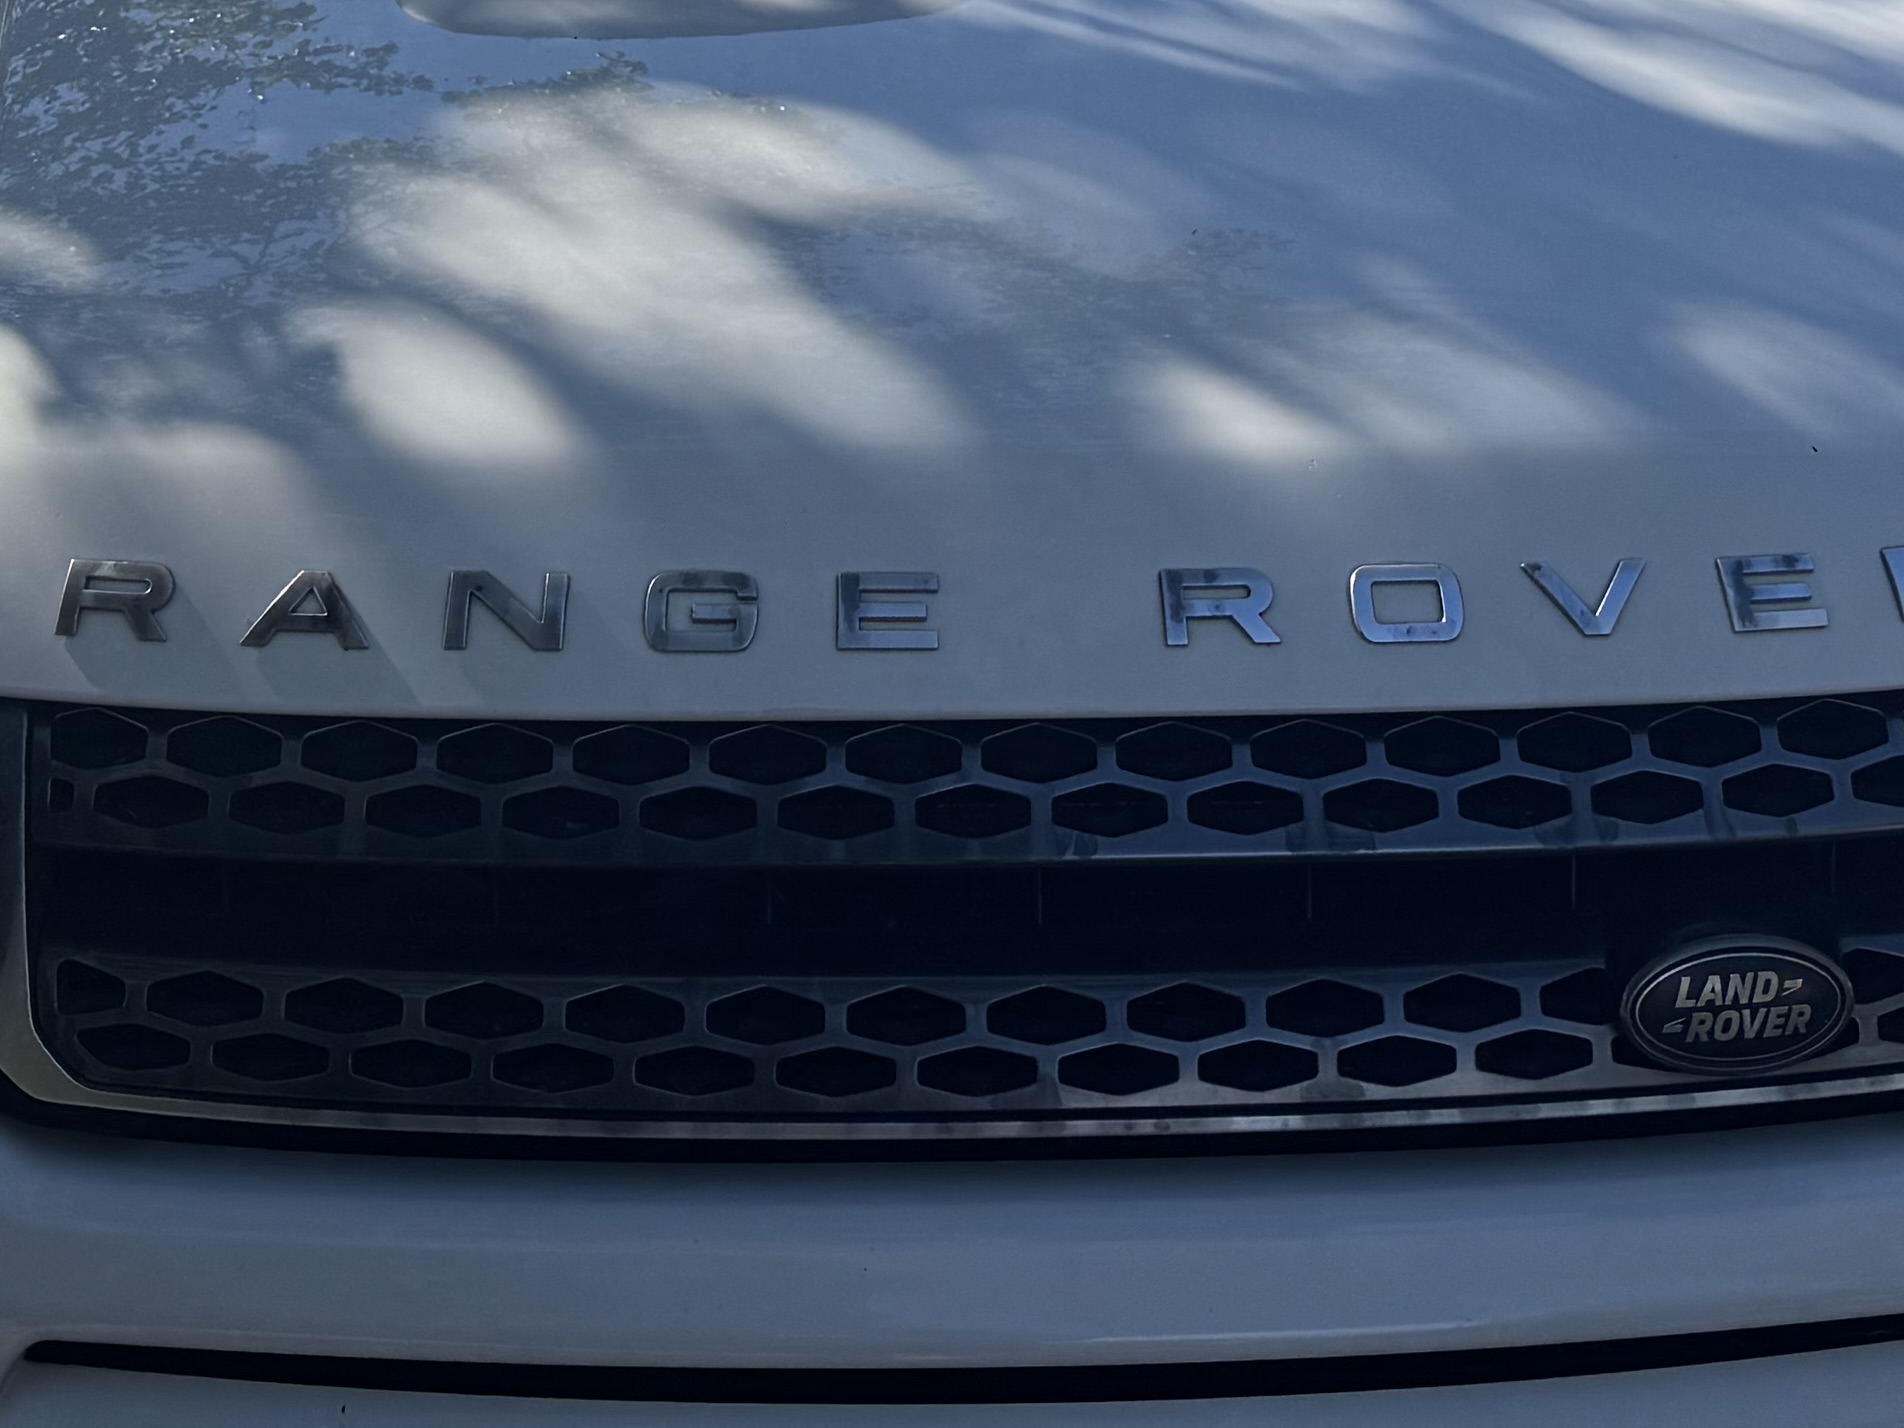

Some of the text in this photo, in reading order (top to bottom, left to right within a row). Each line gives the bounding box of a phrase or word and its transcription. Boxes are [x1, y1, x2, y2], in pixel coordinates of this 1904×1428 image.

[53, 557, 941, 654] RANGE
[1674, 970, 1780, 1009] LAND
[1684, 1003, 1812, 1044] ROVER
